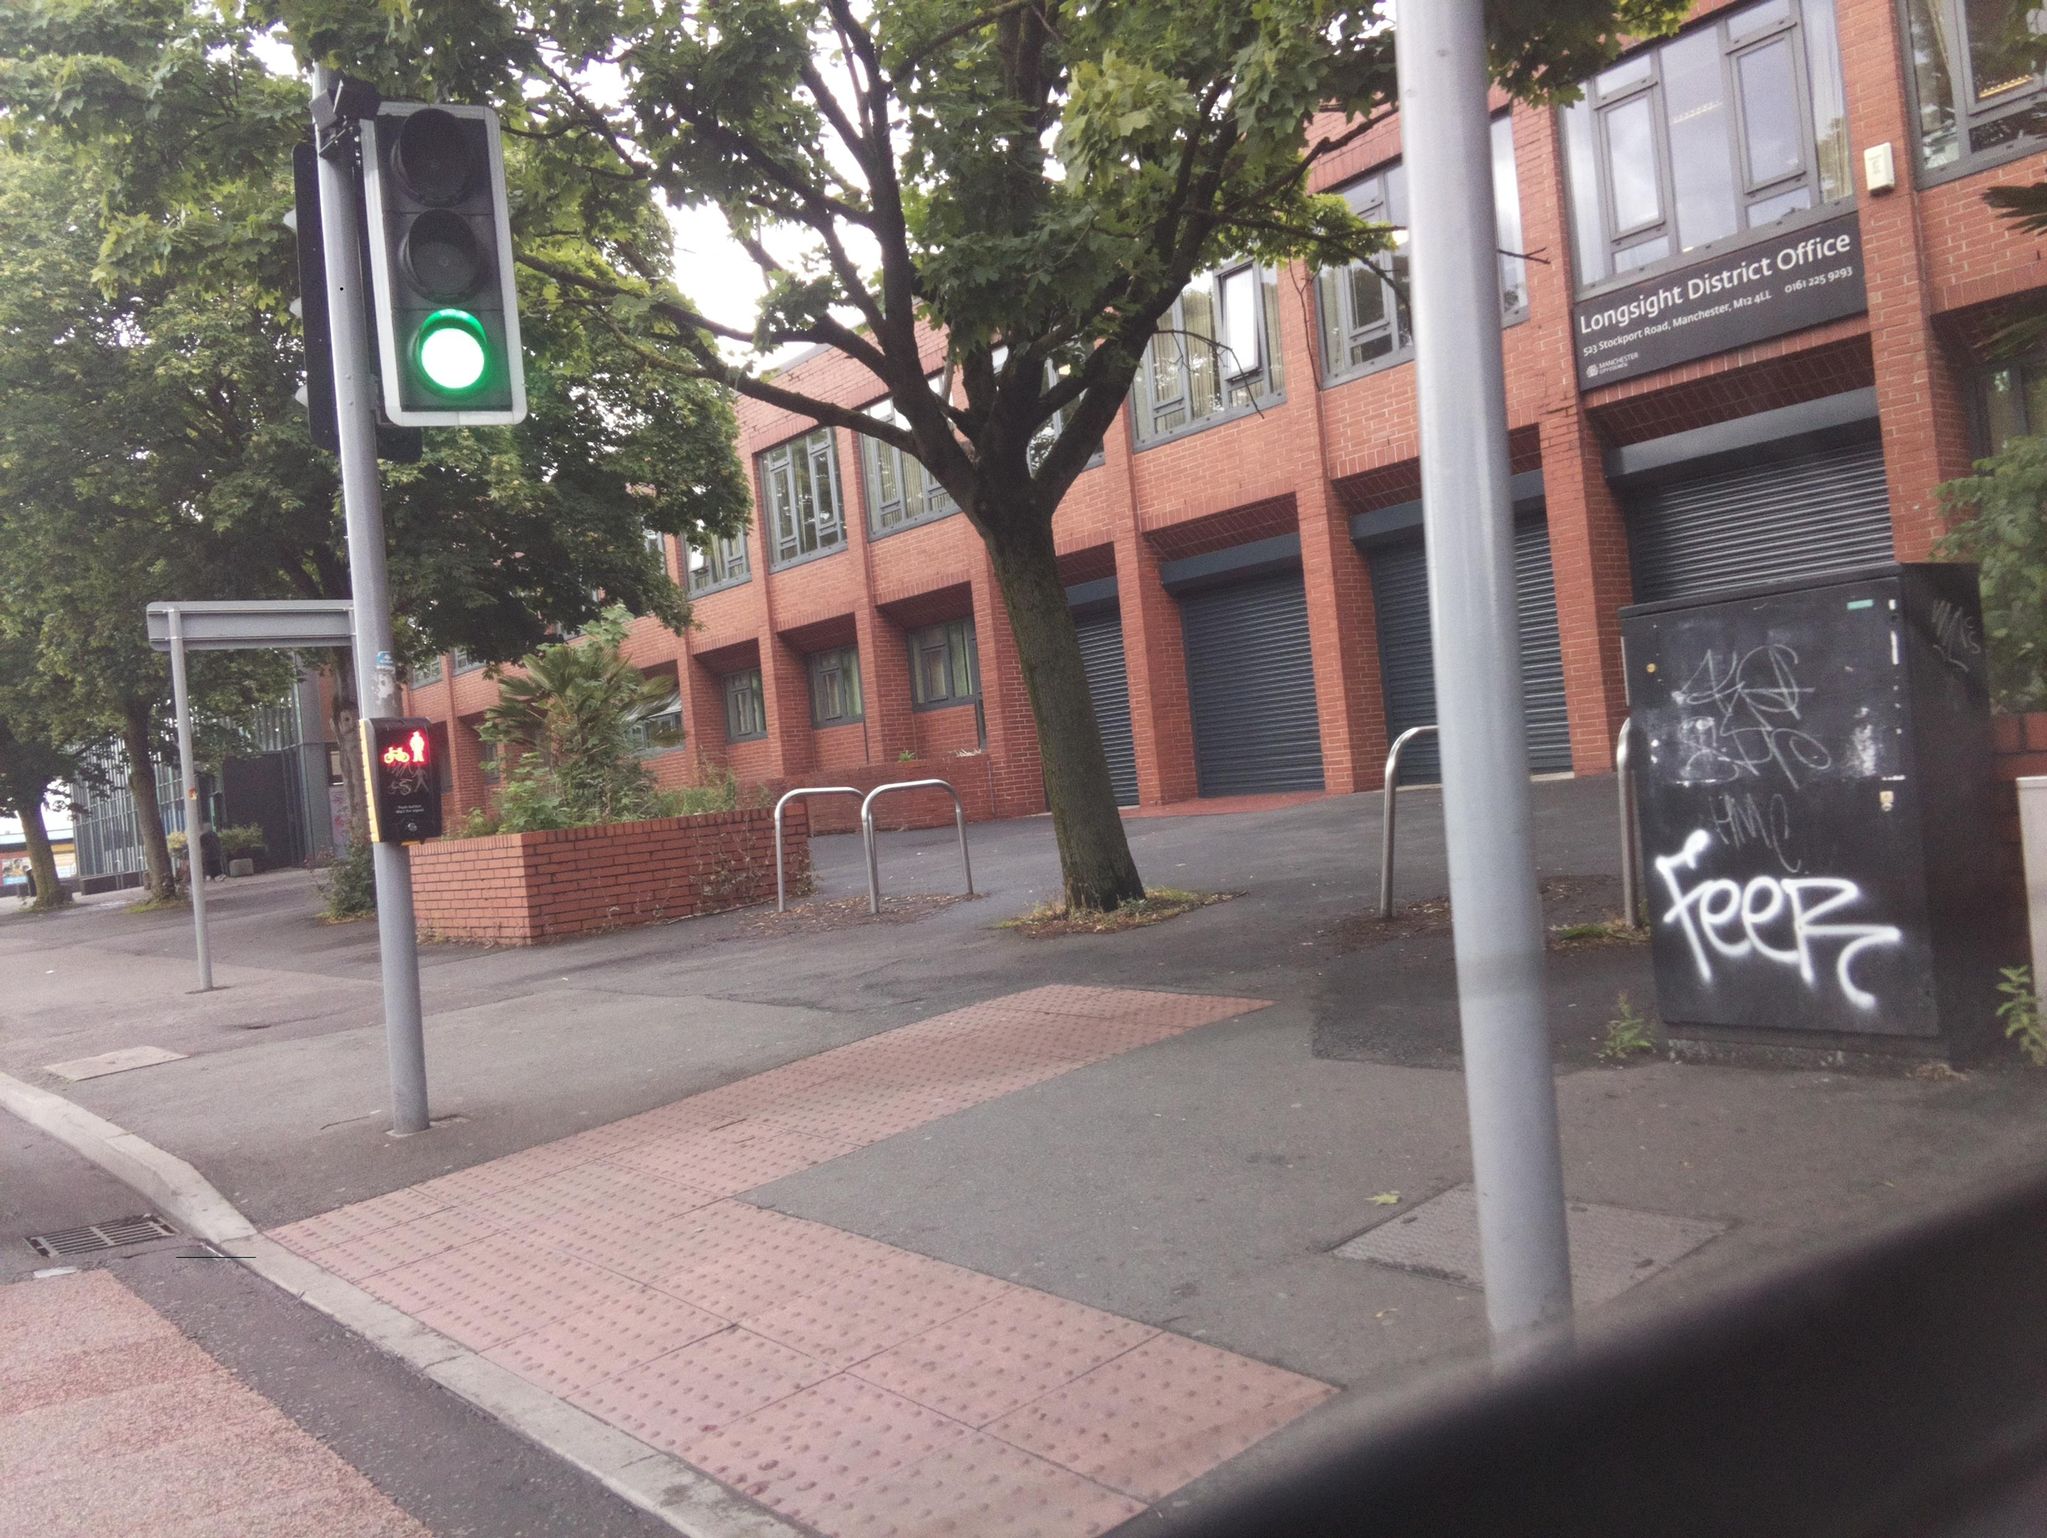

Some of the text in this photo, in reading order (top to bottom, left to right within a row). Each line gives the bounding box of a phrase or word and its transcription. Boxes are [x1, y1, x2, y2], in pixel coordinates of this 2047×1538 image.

[1580, 234, 1851, 335] Longsight District Office
[1583, 265, 1853, 357] 523 Stockport Road, Manchester, M12 4LL 0161 225 9293
